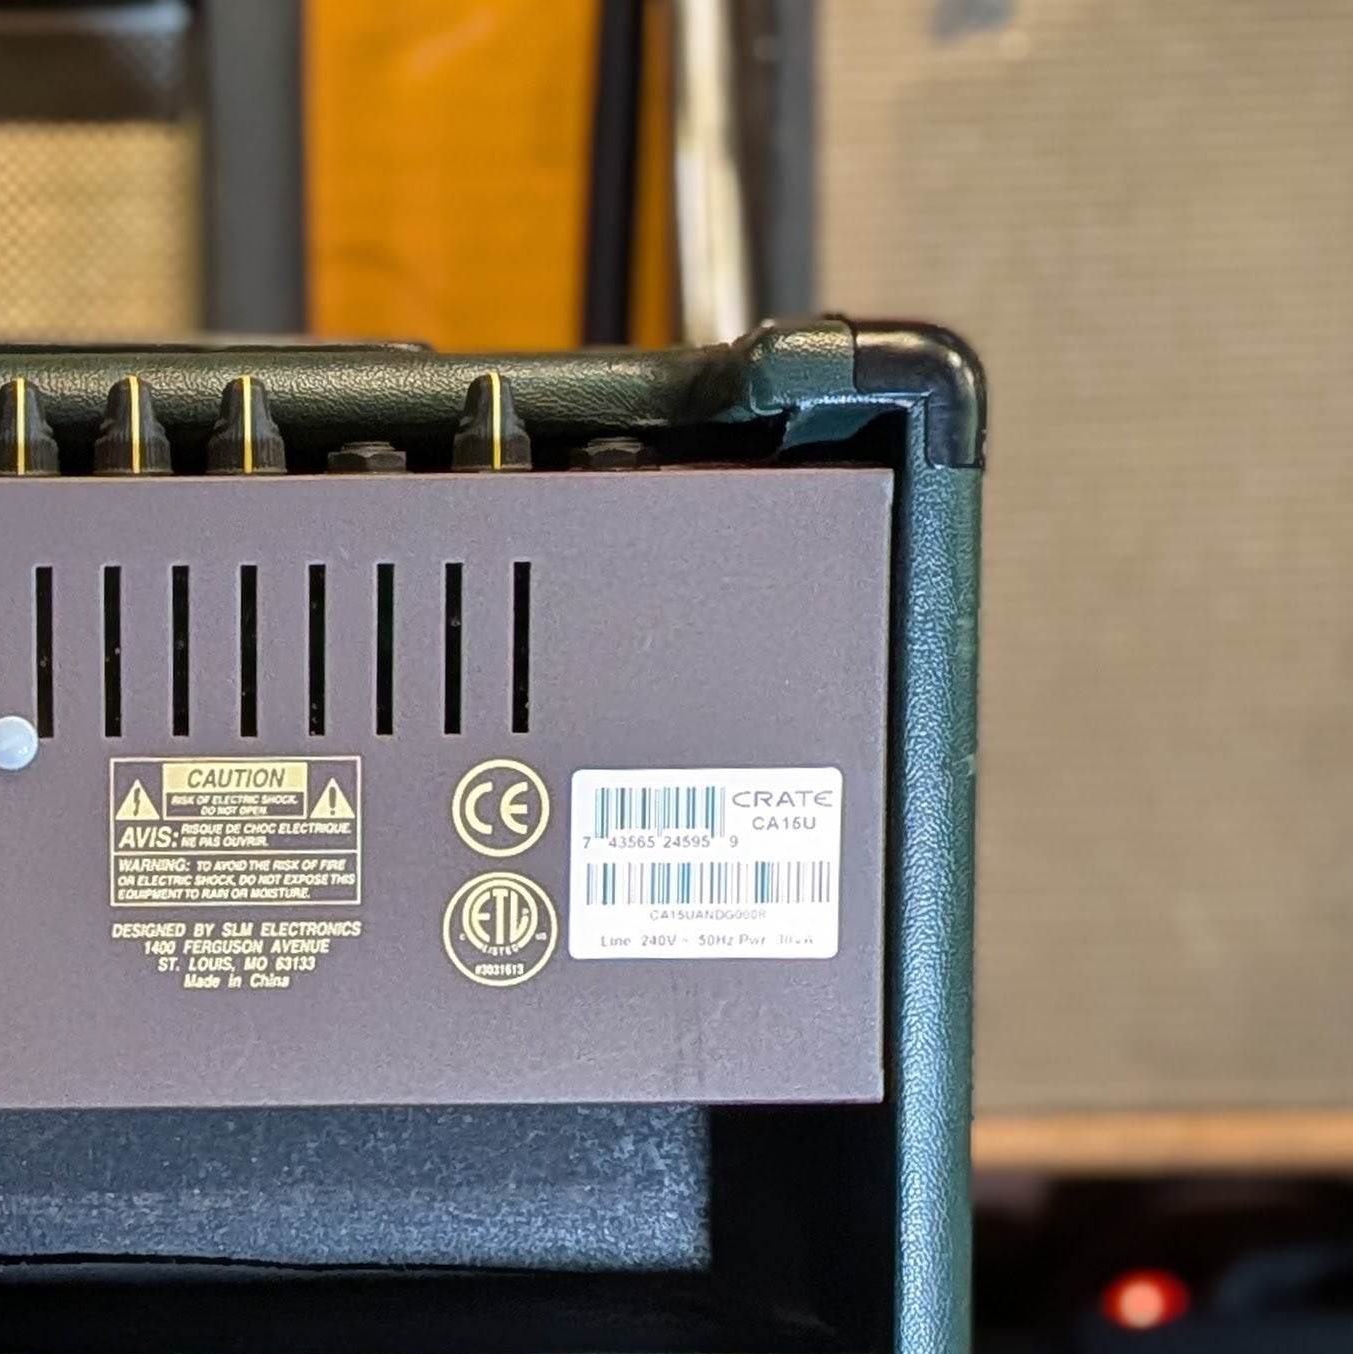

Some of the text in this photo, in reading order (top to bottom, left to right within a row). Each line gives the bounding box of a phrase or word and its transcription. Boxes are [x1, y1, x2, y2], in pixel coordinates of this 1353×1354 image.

[187, 768, 286, 788] CAUTION
[171, 795, 194, 805] RISK
[196, 795, 210, 805] OF
[212, 795, 260, 805] ELECTRIC
[732, 790, 833, 808] CRATE
[201, 806, 216, 816] DO
[217, 806, 237, 816] NOT
[465, 780, 528, 835] CE
[181, 824, 223, 835] RISQUE
[225, 824, 241, 835] DE
[244, 823, 276, 835] CHOC
[119, 826, 179, 849] AVIS:
[181, 836, 197, 848] NE
[199, 836, 220, 848] PAS
[582, 834, 739, 849] 7 43565 24595 9
[118, 858, 346, 872] WARNING: TO AVOID THE RISK OF FIRE
[118, 875, 135, 887] OR
[137, 874, 191, 886] ELECTRIC
[239, 874, 255, 886] DO
[257, 874, 280, 886] NOT
[283, 873, 328, 885] EXPOSE
[330, 873, 355, 885] THIS
[118, 888, 184, 900] EQUIPMENT
[184, 888, 199, 900] TO
[201, 888, 229, 900] RAIN
[231, 888, 248, 899] OR
[471, 888, 529, 945] ETL
[112, 921, 362, 938] DESIGNED BY SLM ELECTRONICS
[144, 939, 331, 955] 1400 FERGUSON AVENUE
[600, 934, 632, 947] Line
[641, 934, 677, 947] 240V
[698, 934, 733, 947] 50Hz
[158, 956, 316, 972] ST. LOUIS, MO 63133
[183, 973, 290, 988] Made in China
